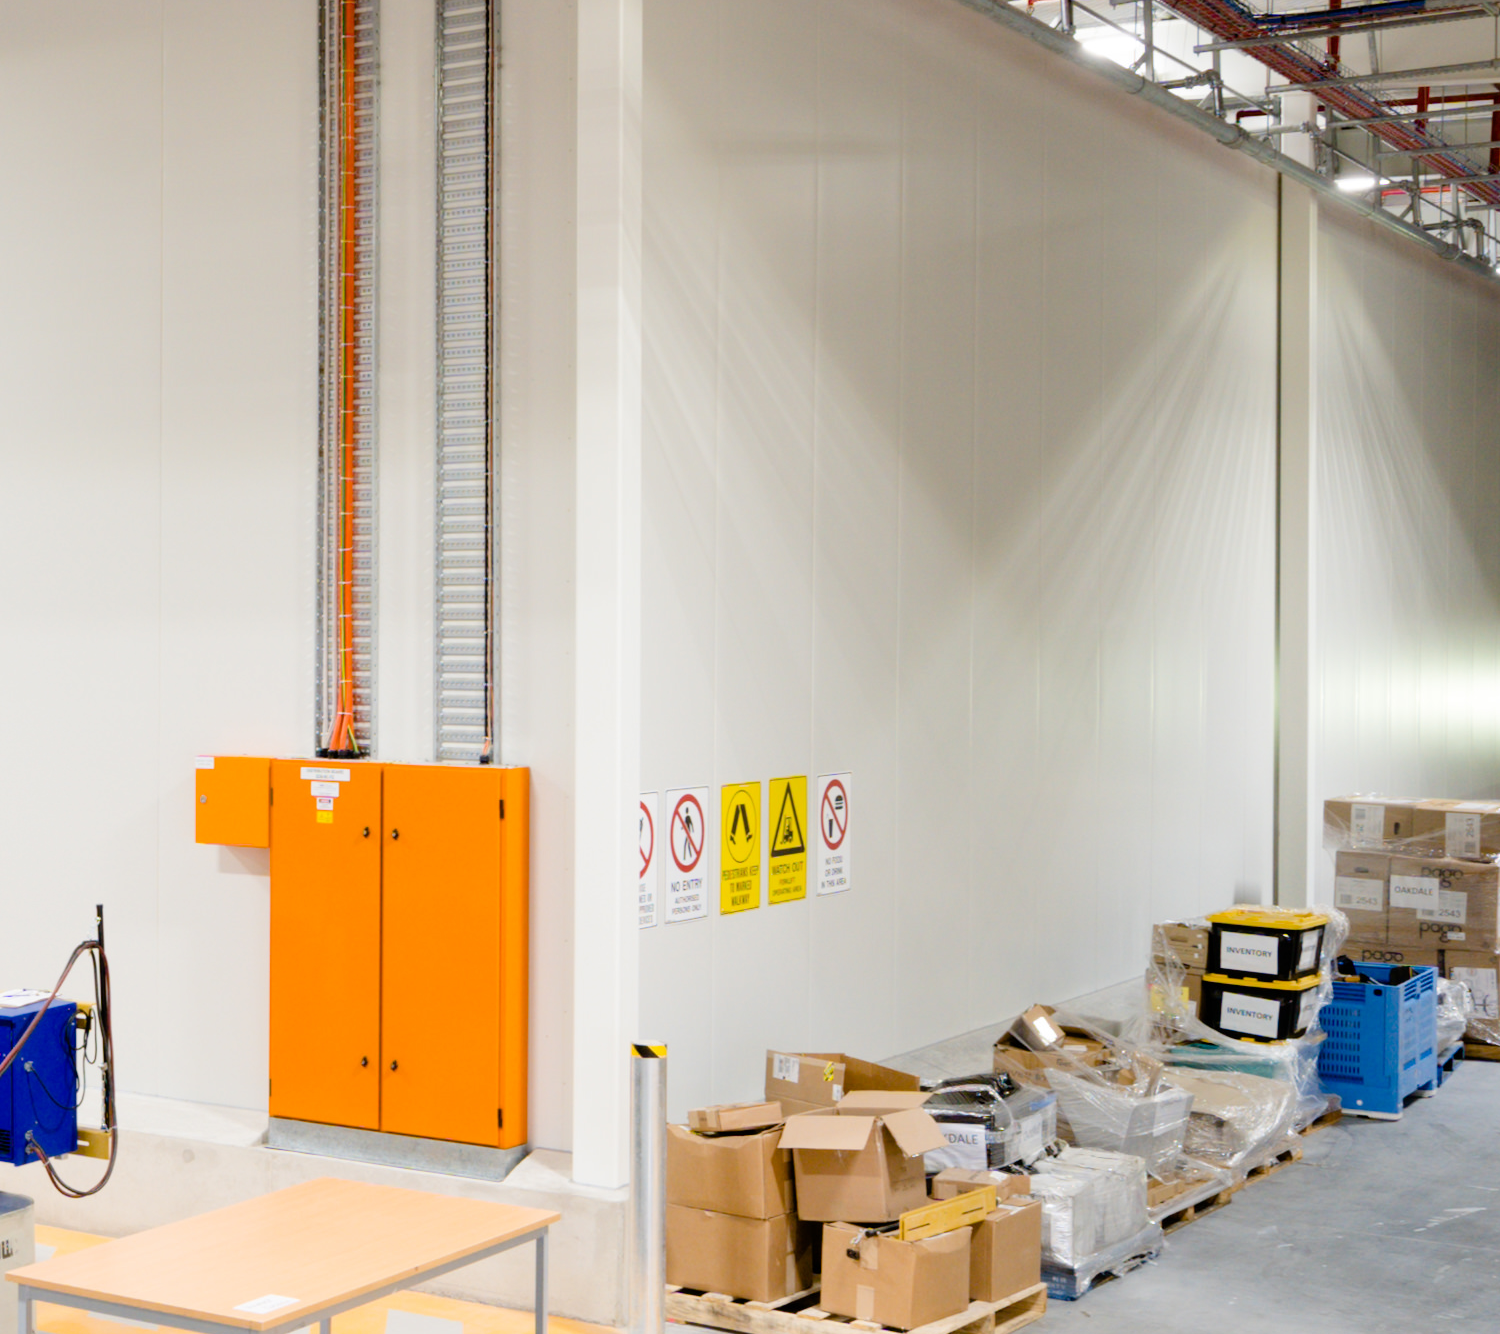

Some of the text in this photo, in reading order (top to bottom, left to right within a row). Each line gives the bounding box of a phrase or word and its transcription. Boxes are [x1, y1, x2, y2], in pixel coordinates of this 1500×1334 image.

[671, 877, 703, 892] NO ENTRY
[1394, 885, 1433, 897] OAKDALE
[1226, 946, 1273, 958] INVENTORY
[1226, 1007, 1273, 1021] INVENTORY
